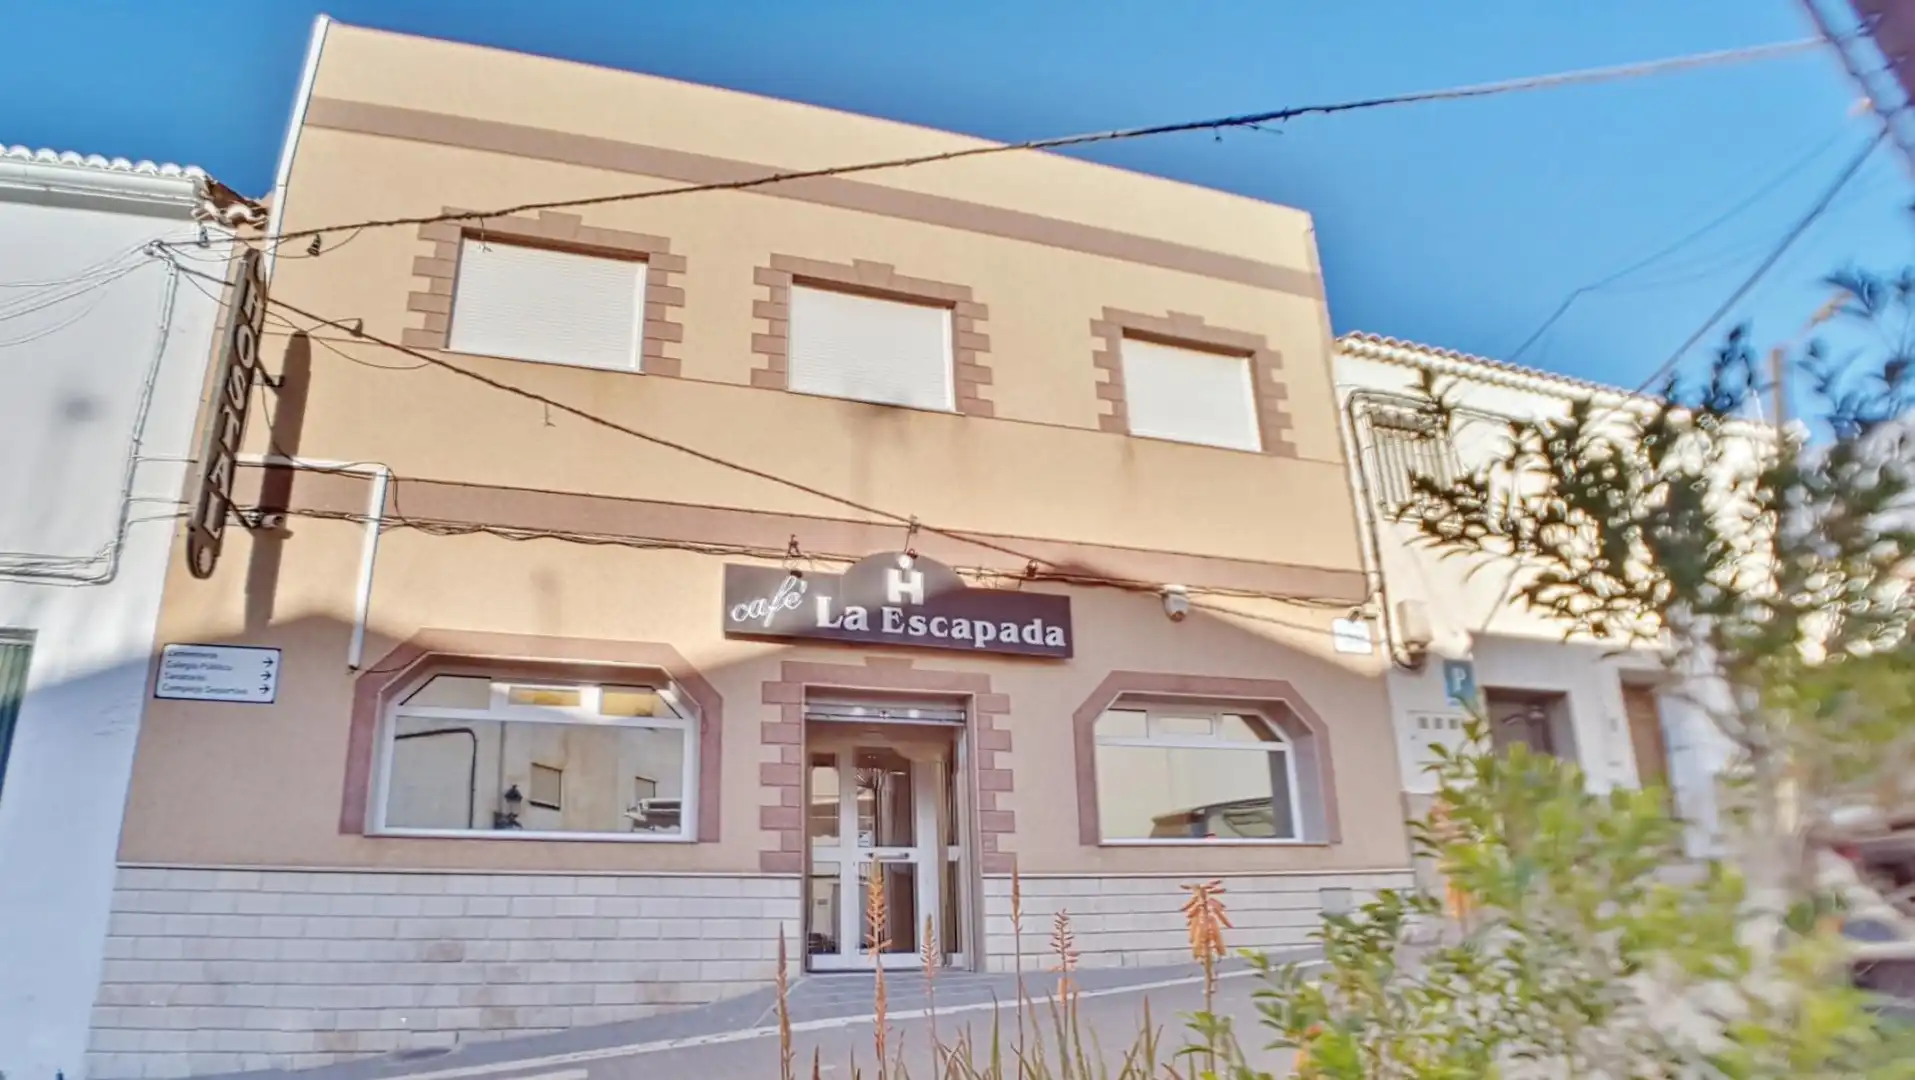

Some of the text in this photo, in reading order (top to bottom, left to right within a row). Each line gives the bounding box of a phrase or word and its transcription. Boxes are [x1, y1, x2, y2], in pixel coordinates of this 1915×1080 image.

[203, 278, 264, 540] HOSTAL
[730, 574, 1067, 648] café La Escapada
[887, 568, 925, 606] H
